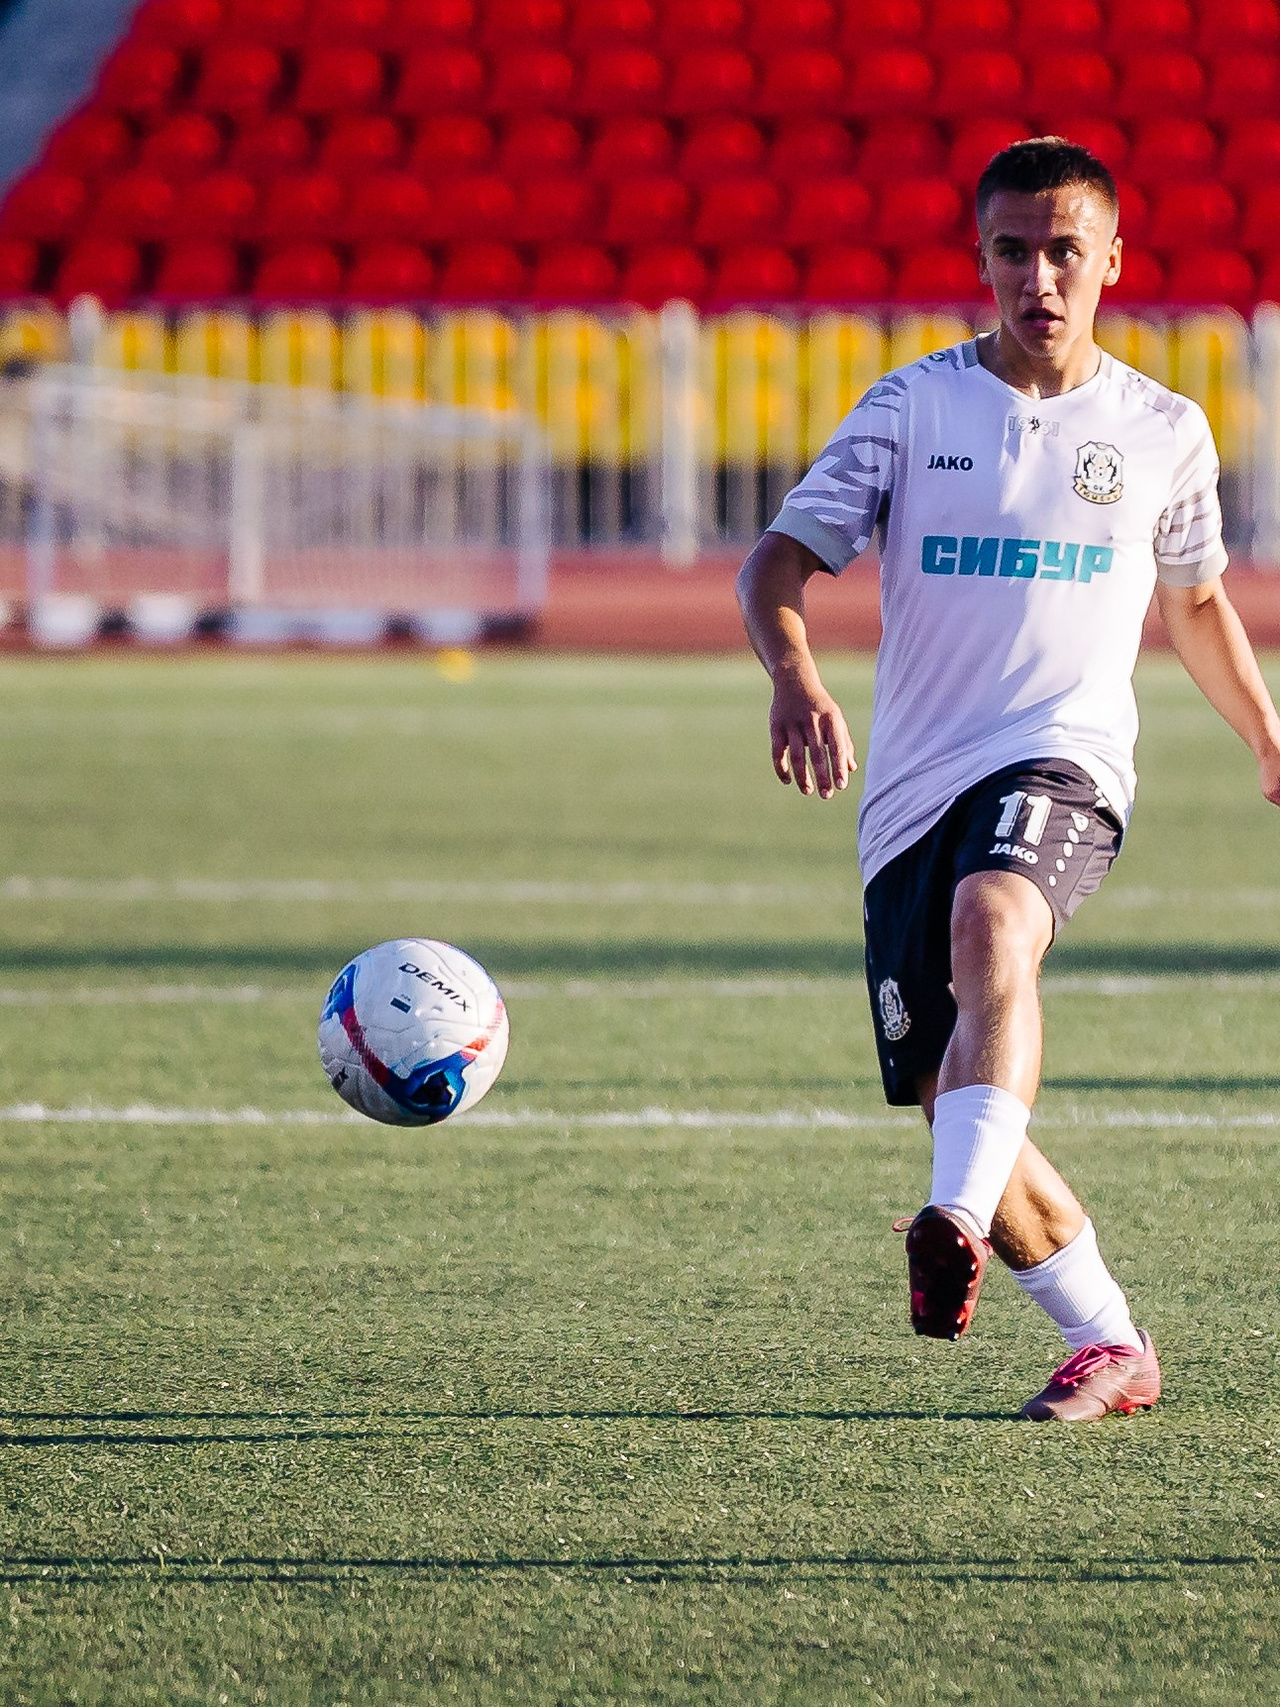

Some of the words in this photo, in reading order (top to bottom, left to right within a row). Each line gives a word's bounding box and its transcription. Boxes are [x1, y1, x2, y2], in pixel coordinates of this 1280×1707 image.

[927, 454, 974, 471] JAKO
[922, 535, 1114, 583] СИБУР
[994, 790, 1052, 846] 11
[989, 843, 1039, 865] JAKO
[398, 962, 472, 1012] DEMIX
